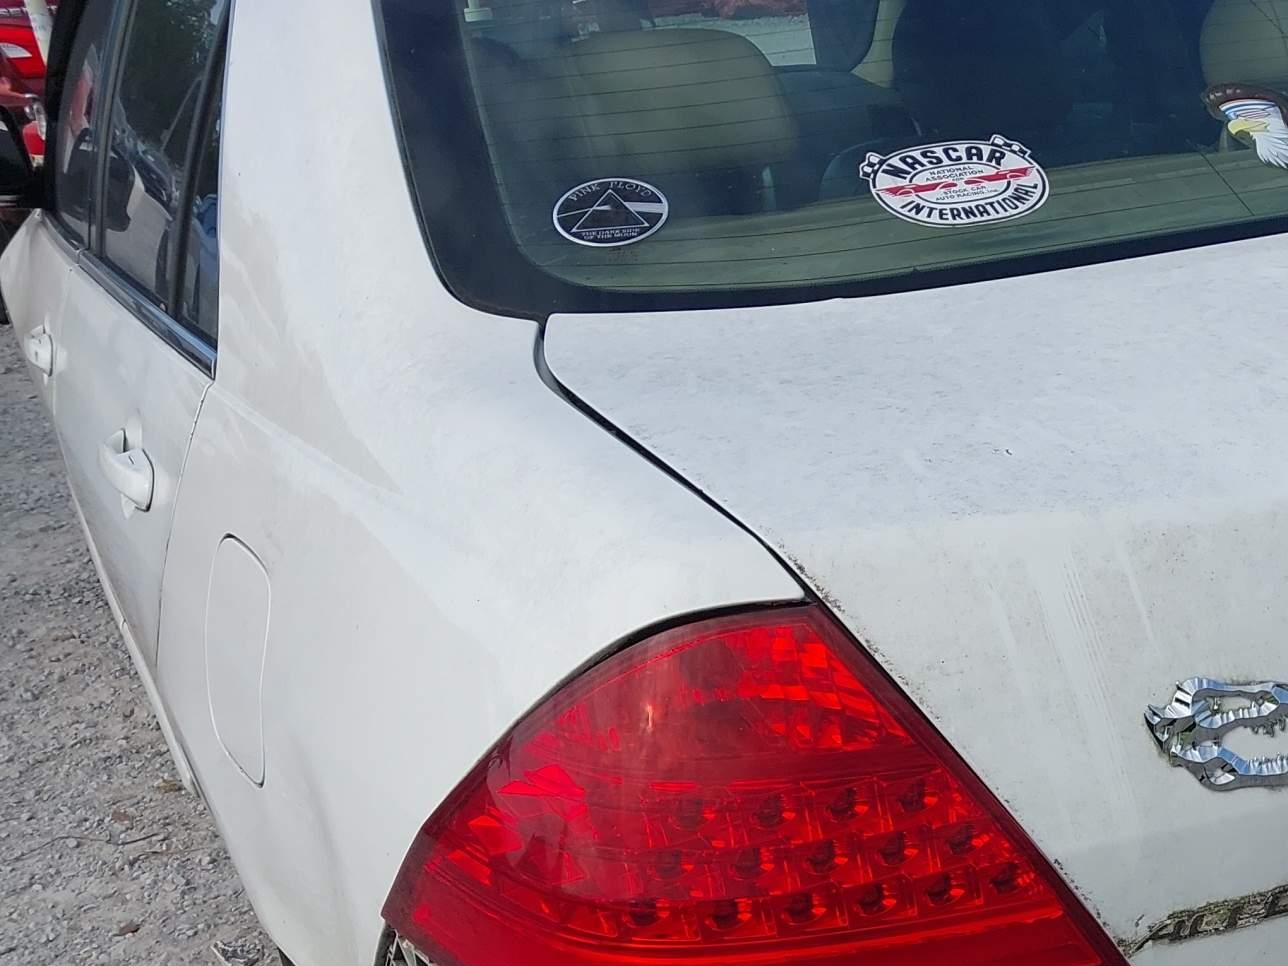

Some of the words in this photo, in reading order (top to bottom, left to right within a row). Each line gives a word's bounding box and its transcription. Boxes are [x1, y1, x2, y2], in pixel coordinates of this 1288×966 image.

[881, 146, 1006, 180] NASCAR
[929, 165, 975, 176] NATIONAL
[926, 169, 985, 182] ASSOCIATION
[568, 183, 600, 201] PINK
[900, 183, 1039, 221] INTERNATIONAL
